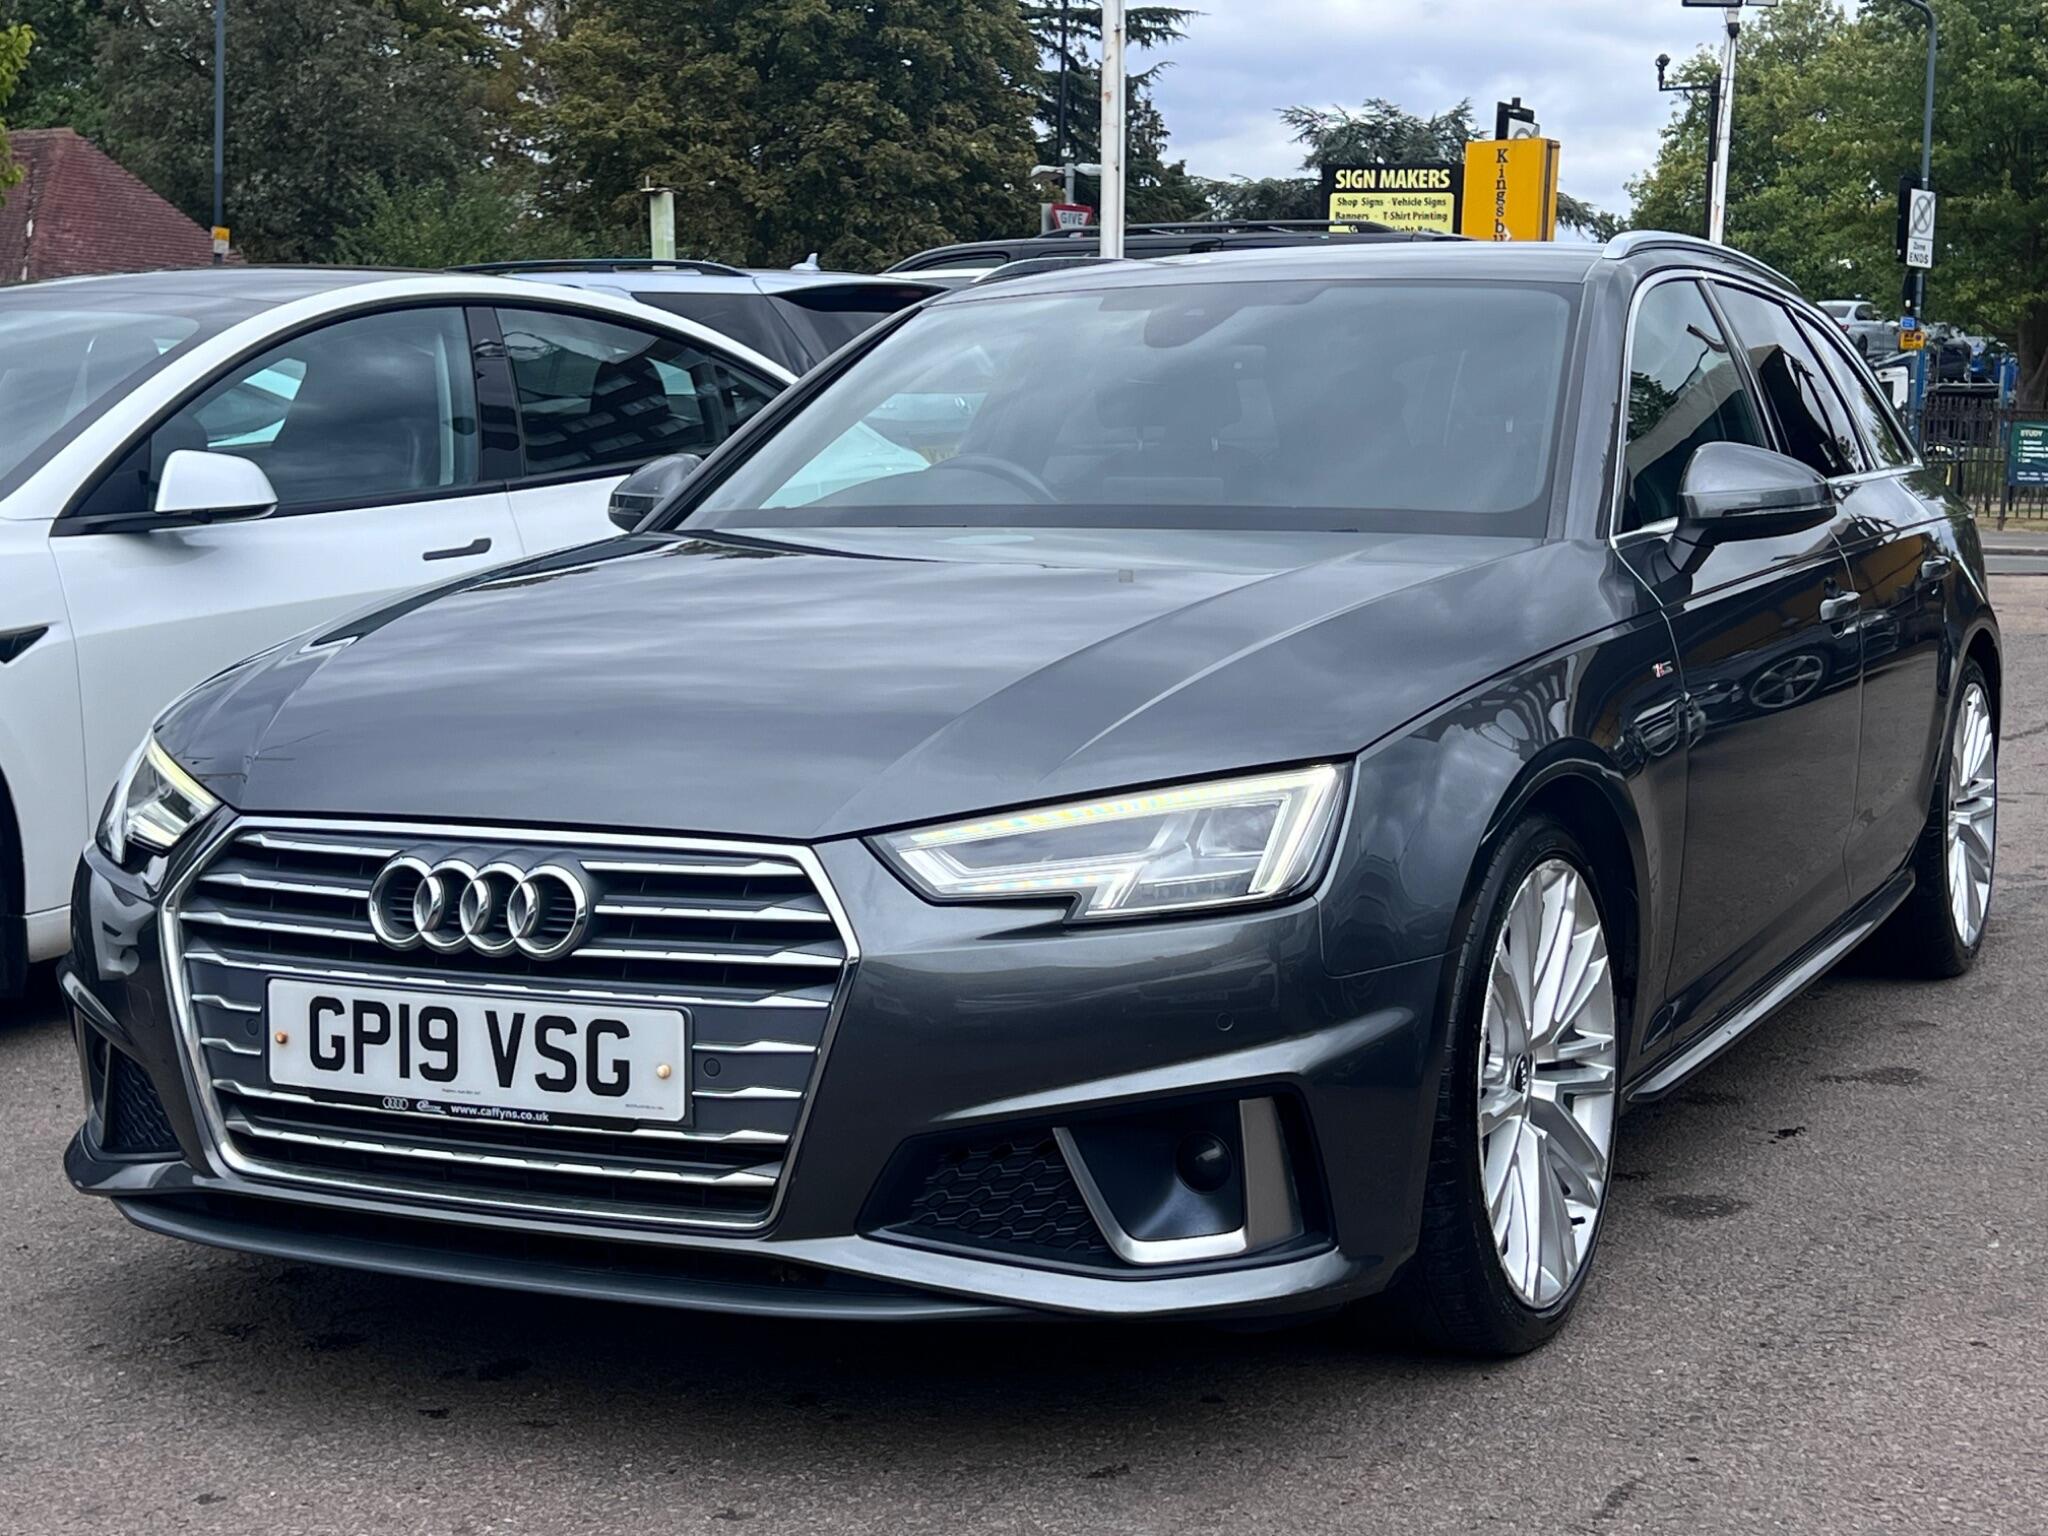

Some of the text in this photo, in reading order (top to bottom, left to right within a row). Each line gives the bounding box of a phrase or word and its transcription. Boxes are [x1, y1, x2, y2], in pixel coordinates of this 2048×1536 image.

[1335, 169, 1451, 189] SIGN MAKERS
[1337, 197, 1447, 208] Shop Signs Vehicle Signs
[1060, 212, 1083, 226] GIVE
[1335, 212, 1448, 222] Banners T-Shirt Printing
[1913, 241, 1926, 251] Zone
[1909, 254, 1929, 265] ENDS
[2020, 429, 2043, 438] STUDY
[308, 995, 631, 1098] GP19 VSG
[451, 1104, 549, 1122] www.caffyns.co.uk
